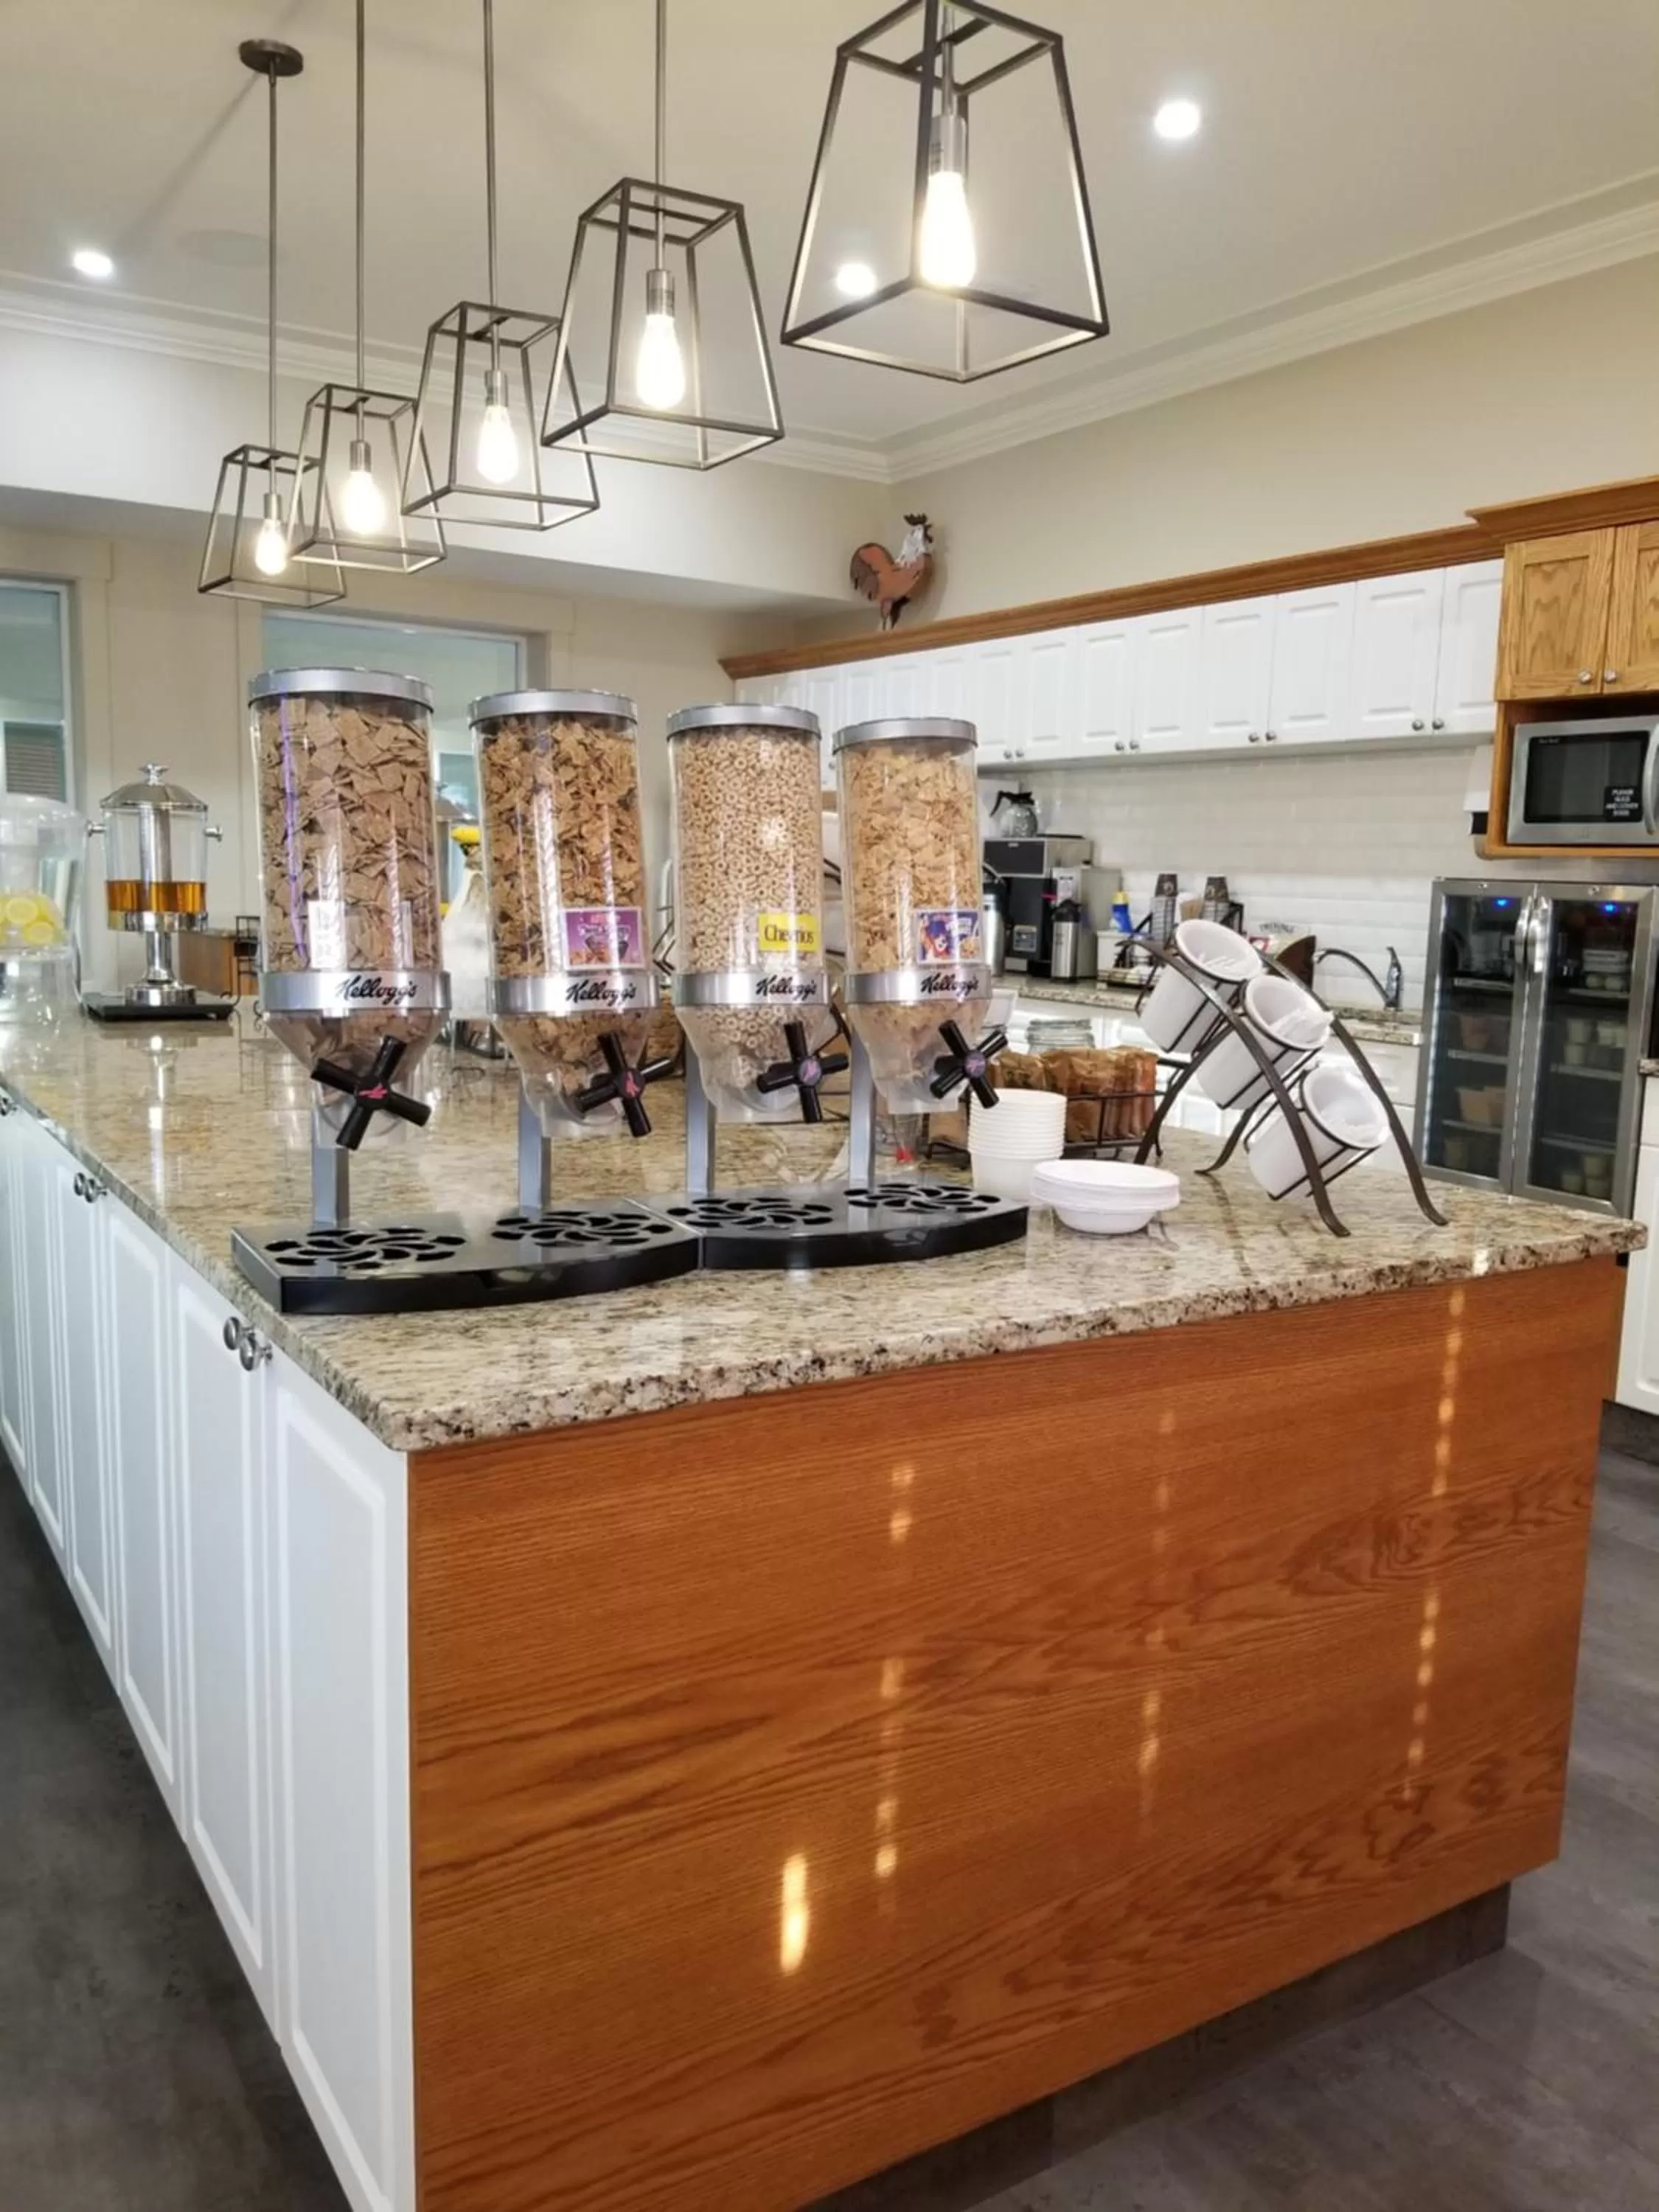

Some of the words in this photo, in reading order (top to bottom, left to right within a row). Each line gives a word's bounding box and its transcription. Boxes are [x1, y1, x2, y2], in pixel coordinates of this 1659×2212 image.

[764, 924, 815, 945] Cherios
[335, 974, 418, 1005] Kellogg's
[566, 979, 637, 1006] Kellogg's
[756, 974, 816, 1001] Kellogg's
[920, 973, 979, 996] Kellogg's
